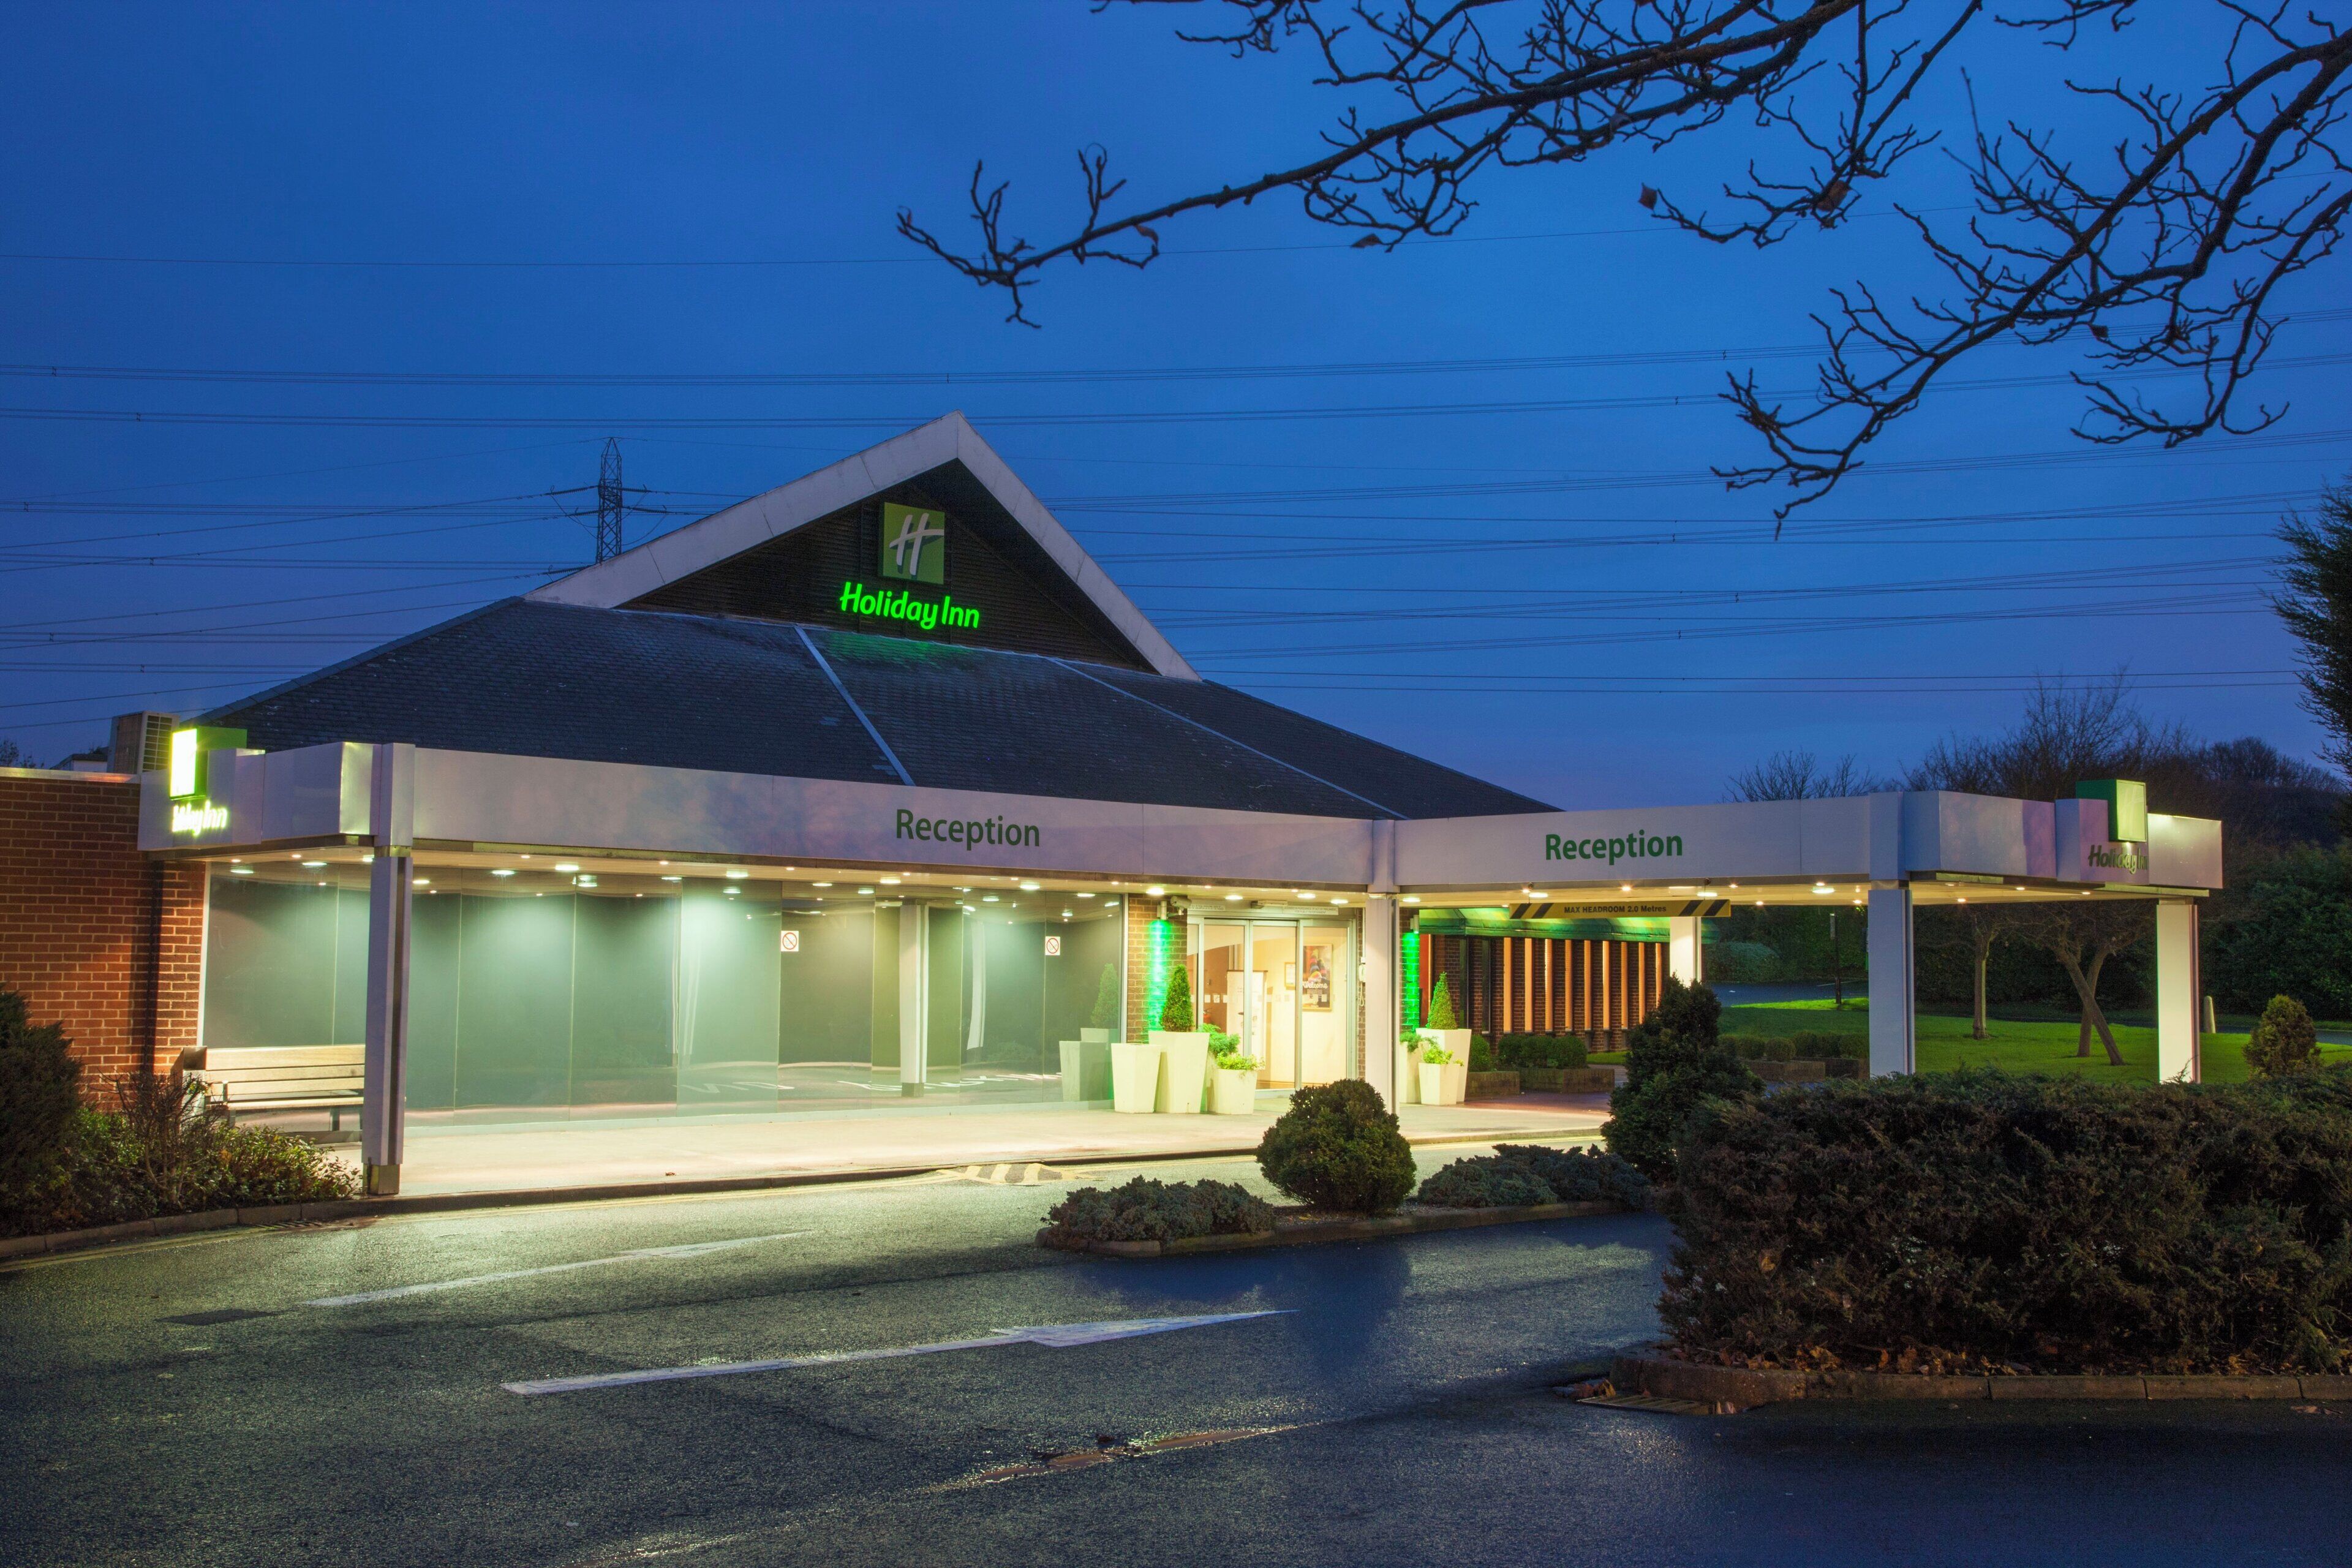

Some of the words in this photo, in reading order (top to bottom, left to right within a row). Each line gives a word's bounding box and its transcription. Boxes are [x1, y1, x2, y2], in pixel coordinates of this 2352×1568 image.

[839, 581, 938, 630] Holiday
[941, 595, 980, 628] Inn
[896, 809, 1040, 851] Reception
[1545, 829, 1683, 866] Reception
[2087, 844, 2137, 875] Holiday
[1302, 981, 1329, 990] Welcome
